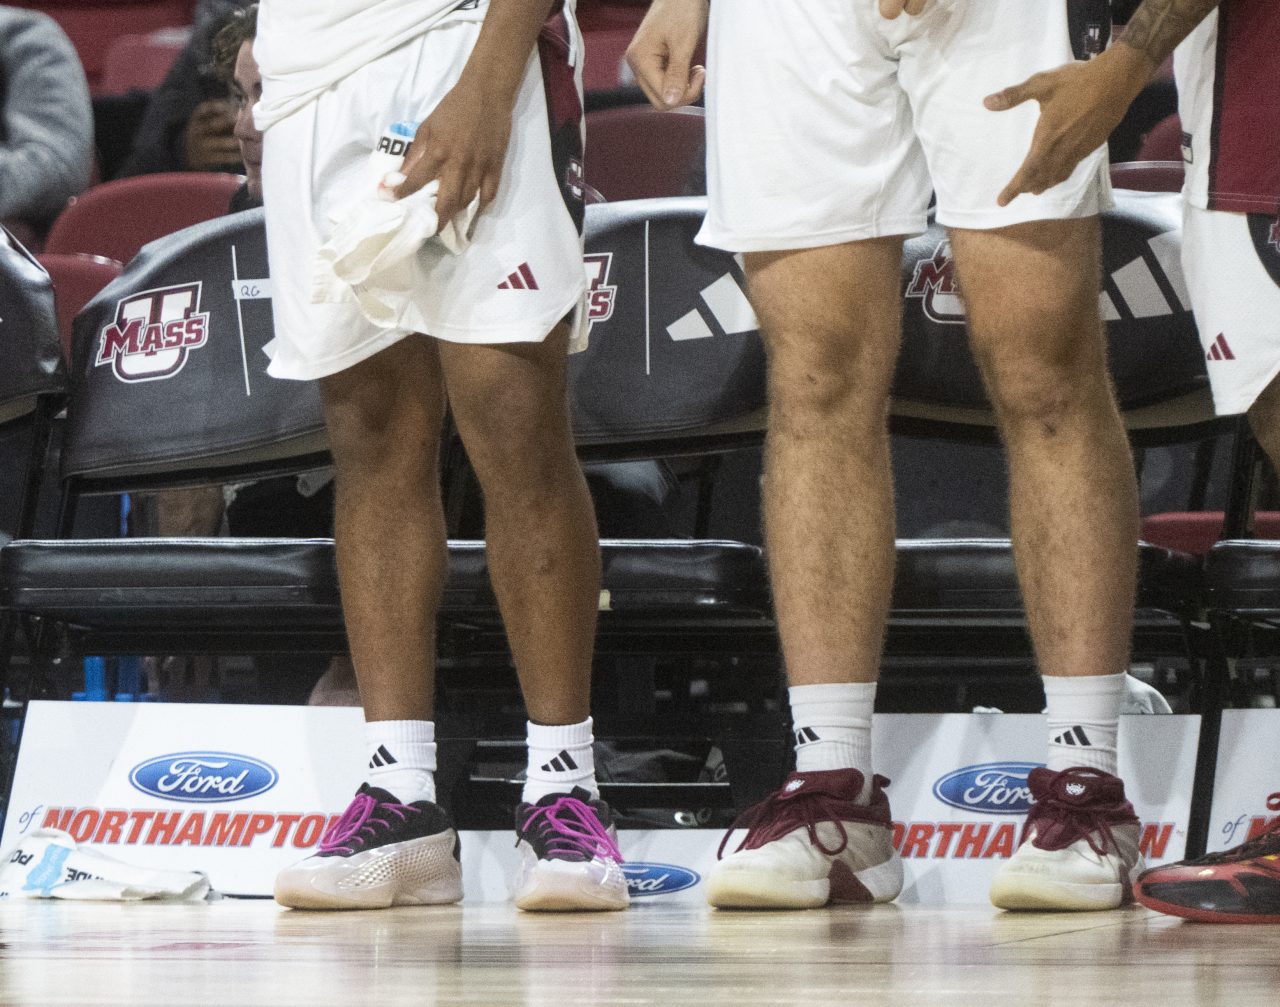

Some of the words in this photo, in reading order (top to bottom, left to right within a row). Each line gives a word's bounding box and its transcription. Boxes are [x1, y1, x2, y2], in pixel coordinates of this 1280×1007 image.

[158, 758, 251, 794] Ford
[19, 804, 44, 834] of
[1223, 814, 1247, 845] of
